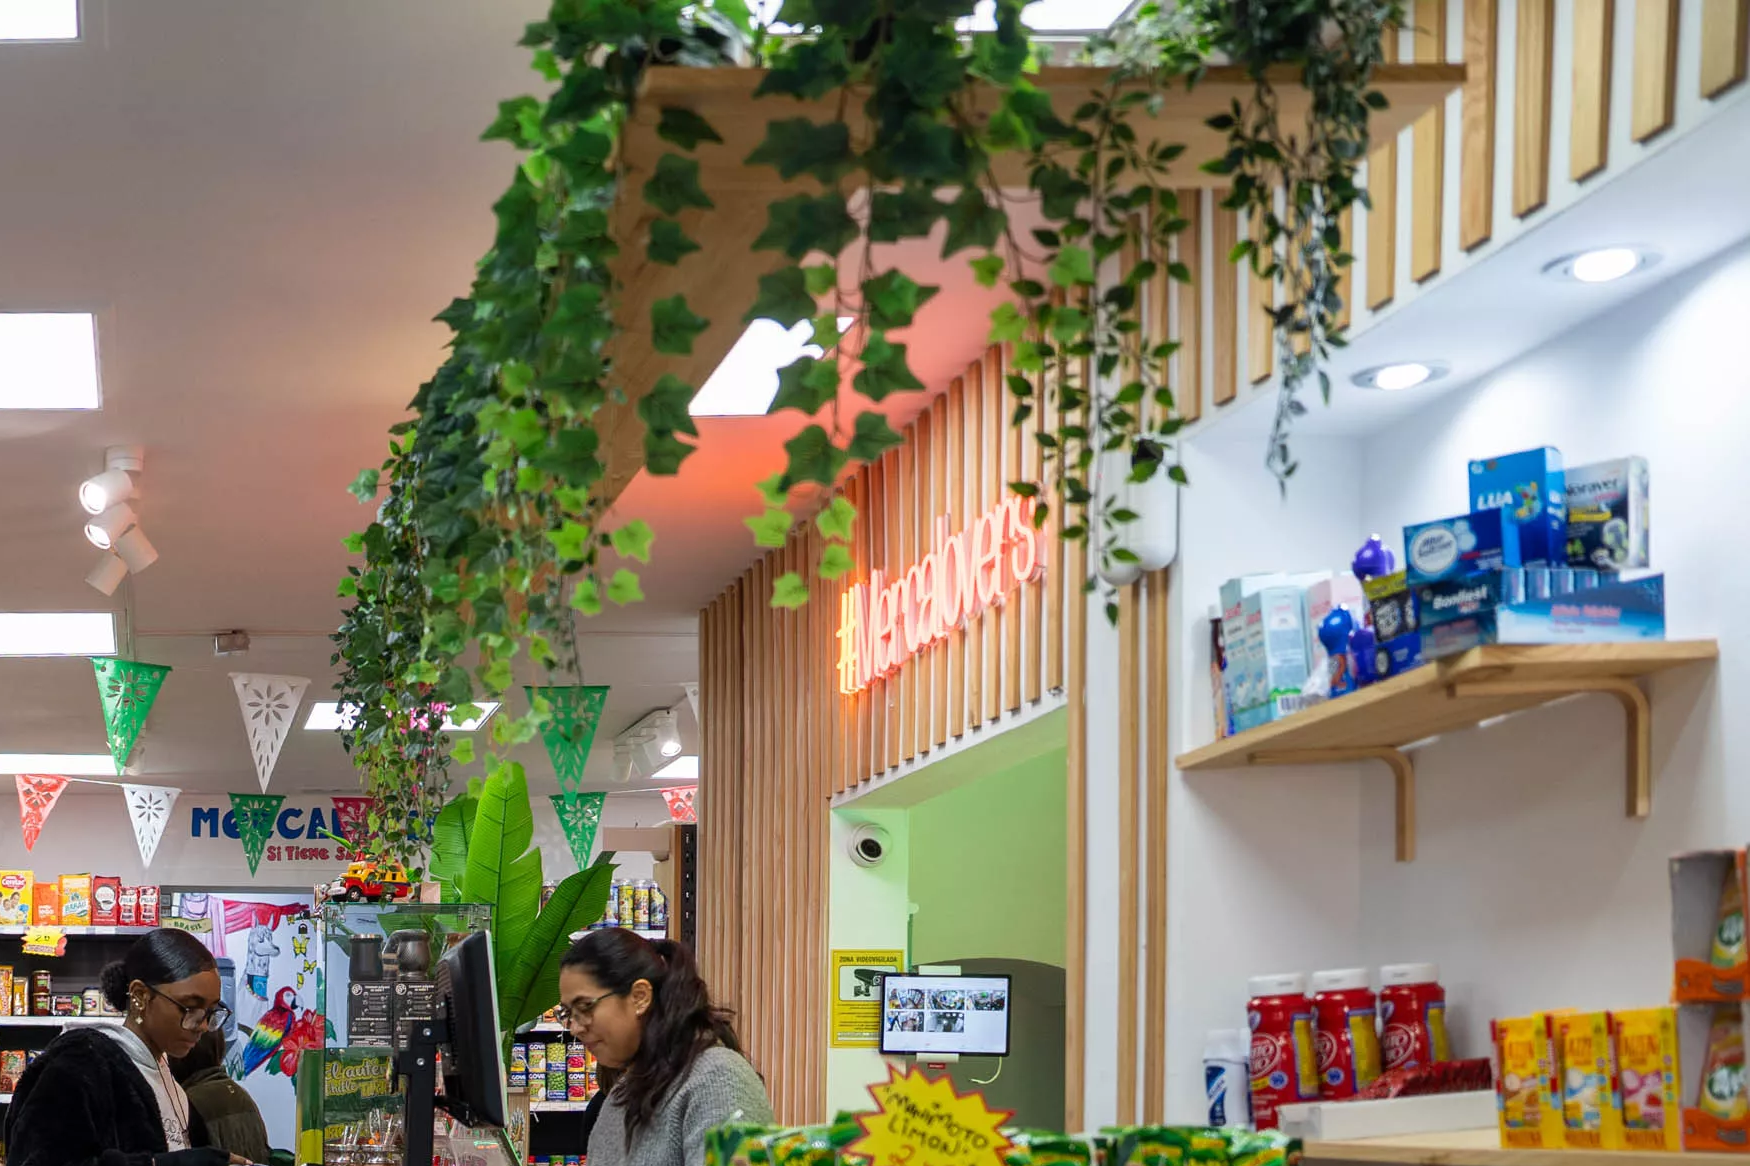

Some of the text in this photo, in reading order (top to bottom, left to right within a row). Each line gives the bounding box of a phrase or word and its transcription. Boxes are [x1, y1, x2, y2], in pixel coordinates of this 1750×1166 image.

[1477, 490, 1514, 509] LUA
[835, 493, 1037, 694] #Mercalovers
[173, 920, 203, 931] BRASIL
